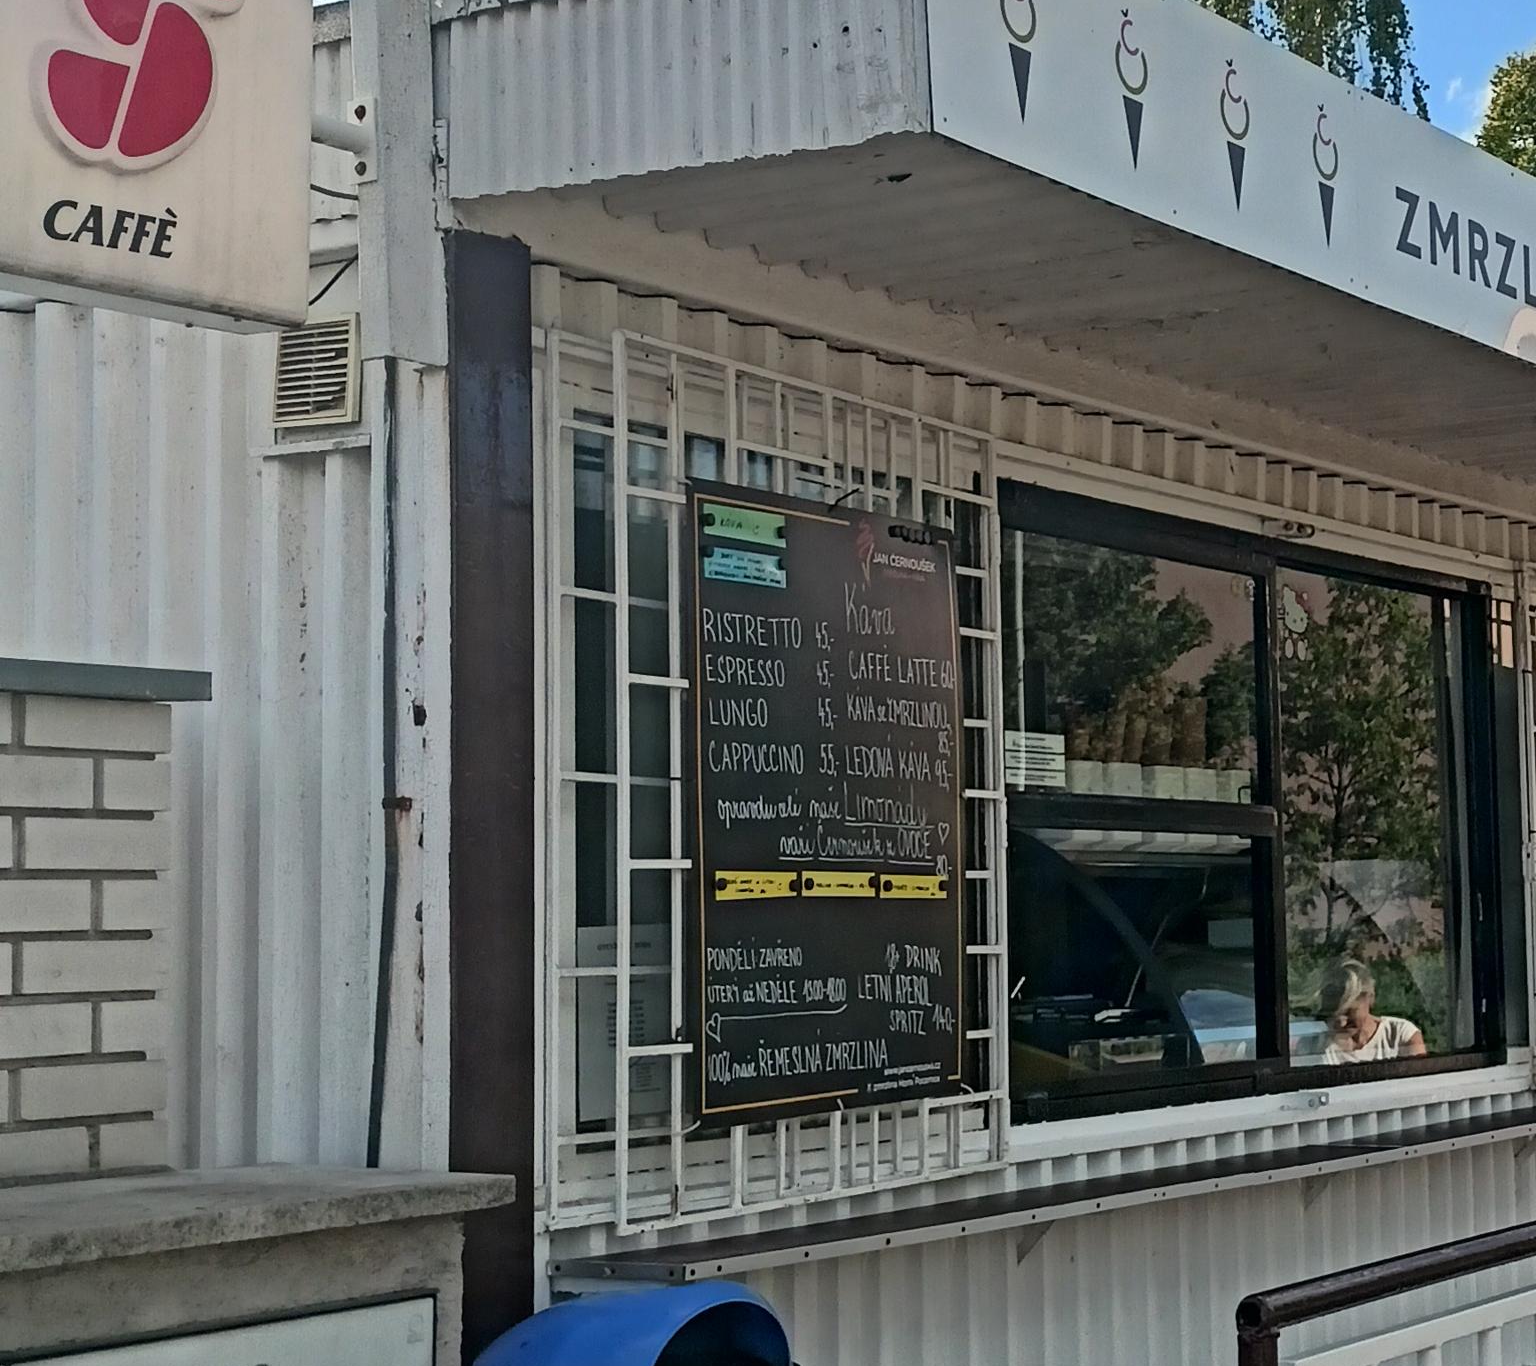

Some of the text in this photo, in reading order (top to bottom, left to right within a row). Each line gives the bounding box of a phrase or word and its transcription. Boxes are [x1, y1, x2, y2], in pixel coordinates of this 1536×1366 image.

[43, 200, 178, 260] CAFFÈ
[873, 552, 889, 565] JAN
[845, 582, 896, 636] Káva
[702, 608, 802, 649] RISTRETTO
[704, 653, 786, 687] ESPRESSO
[898, 655, 938, 687] LATTE
[708, 698, 768, 728] LUNGO
[846, 687, 877, 723] KÁVA
[708, 739, 840, 777] CAPPUCCINO 55,-
[844, 733, 895, 779] LEDOVÁ
[898, 740, 932, 782] KÁVA
[843, 781, 928, 828] Limonády
[707, 936, 802, 971] PONDĚLÍ ZAVŘENO
[904, 944, 943, 977] DRINK
[707, 975, 740, 1004] ÚTERÝ
[755, 973, 798, 1004] NEDĚLE
[895, 974, 934, 1007] APEROL
[889, 1009, 927, 1035] SPRITZ
[708, 1050, 732, 1086] 100%
[757, 1028, 823, 1077] ŘEMESLNÁ
[825, 1038, 888, 1072] ZMRZLINA
